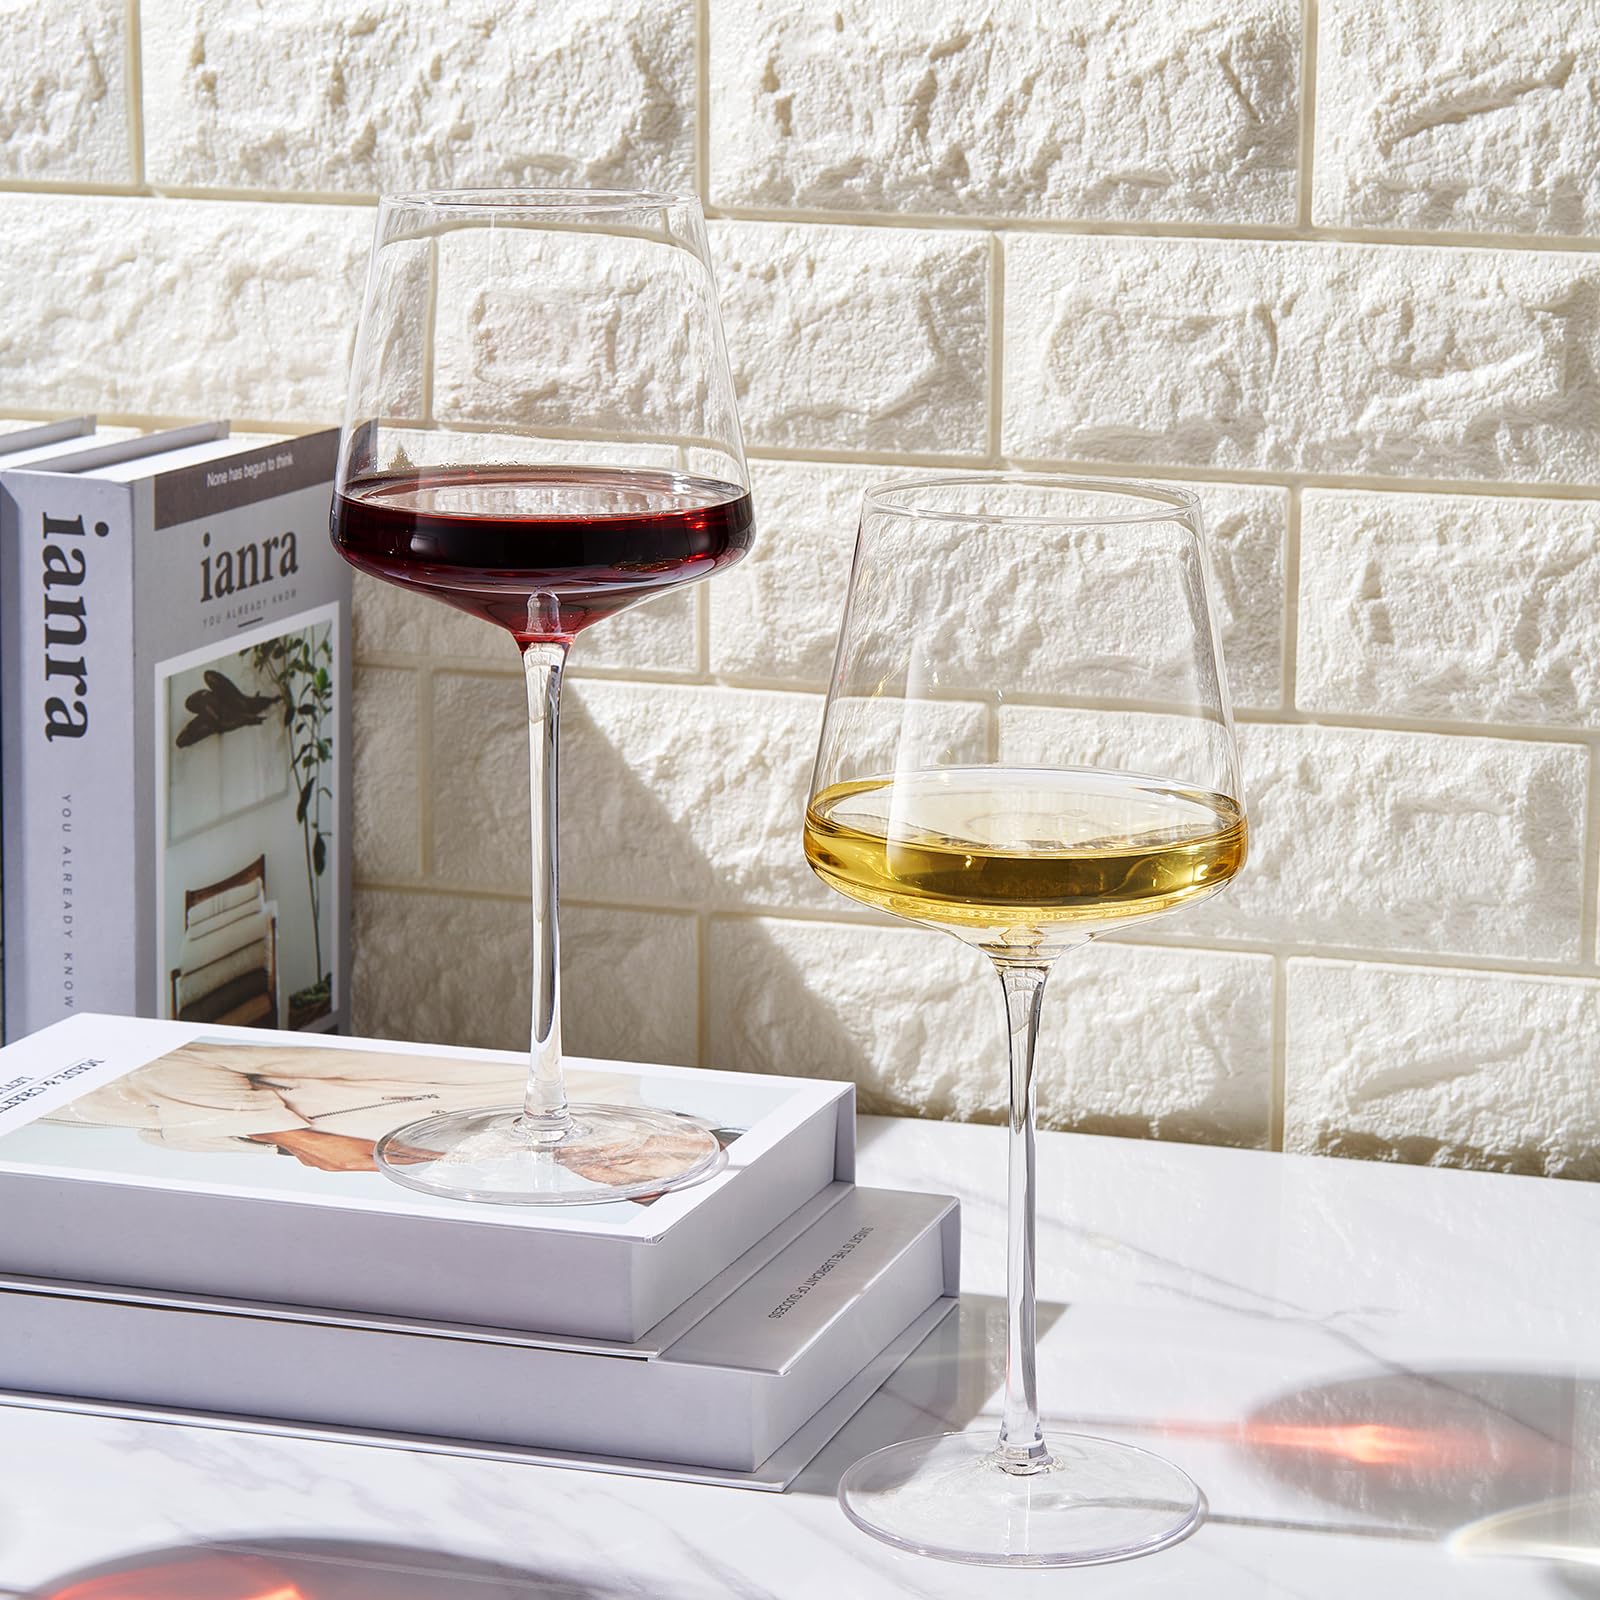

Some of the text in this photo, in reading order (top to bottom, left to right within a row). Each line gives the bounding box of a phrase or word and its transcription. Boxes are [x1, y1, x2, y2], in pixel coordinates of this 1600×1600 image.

[207, 452, 293, 487] None has begun to think
[200, 532, 298, 603] ianra
[42, 511, 110, 743] ianra
[203, 615, 221, 628] YOU
[227, 599, 267, 619] ALREADY
[61, 794, 74, 1008] YOU ALREADY KNOW
[54, 1058, 106, 1081] MADE
[0, 1087, 47, 1114] CRAFT
[831, 1249, 852, 1259] THE
[803, 1259, 841, 1287] LUBRICANT
[796, 1286, 811, 1294] OF
[768, 1294, 803, 1318] SUCCESS
